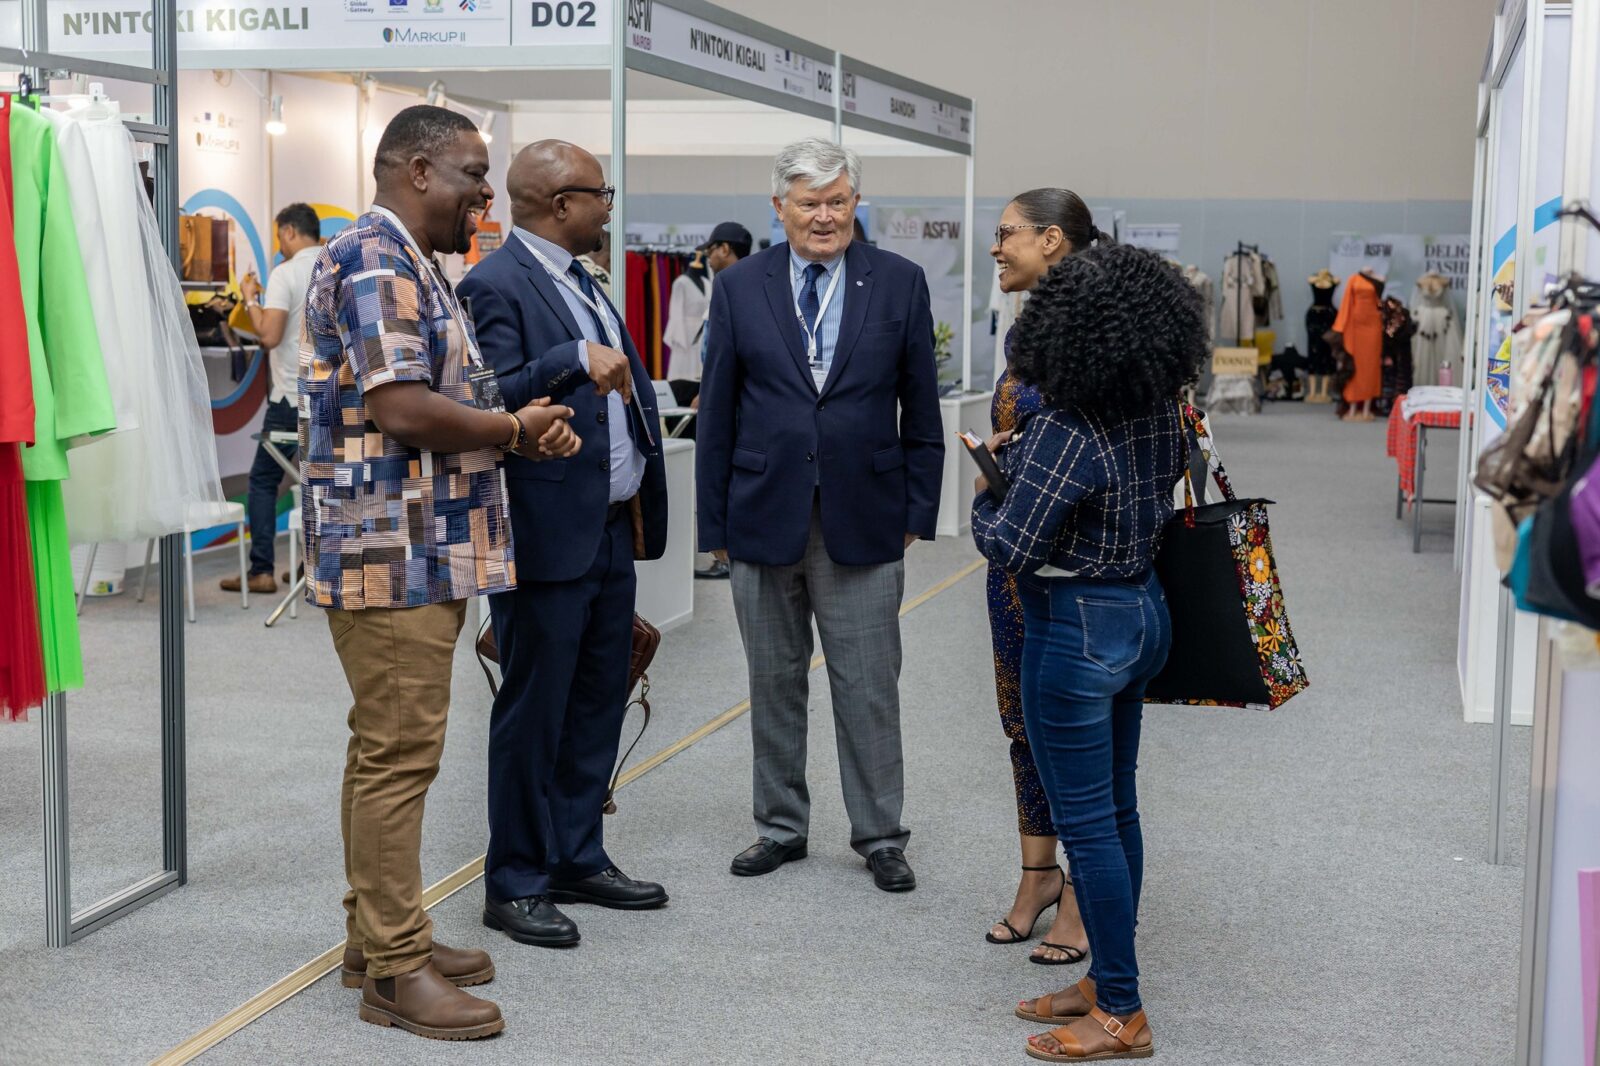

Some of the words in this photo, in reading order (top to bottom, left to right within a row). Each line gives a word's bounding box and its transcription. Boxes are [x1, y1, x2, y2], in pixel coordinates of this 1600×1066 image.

[205, 6, 309, 33] KIGALI
[530, 1, 597, 28] D02
[627, 0, 653, 32] ASFW
[690, 27, 733, 62] N'INTOKI
[735, 43, 766, 72] KIGALI
[817, 69, 833, 93] D02
[922, 221, 961, 240] ASFW
